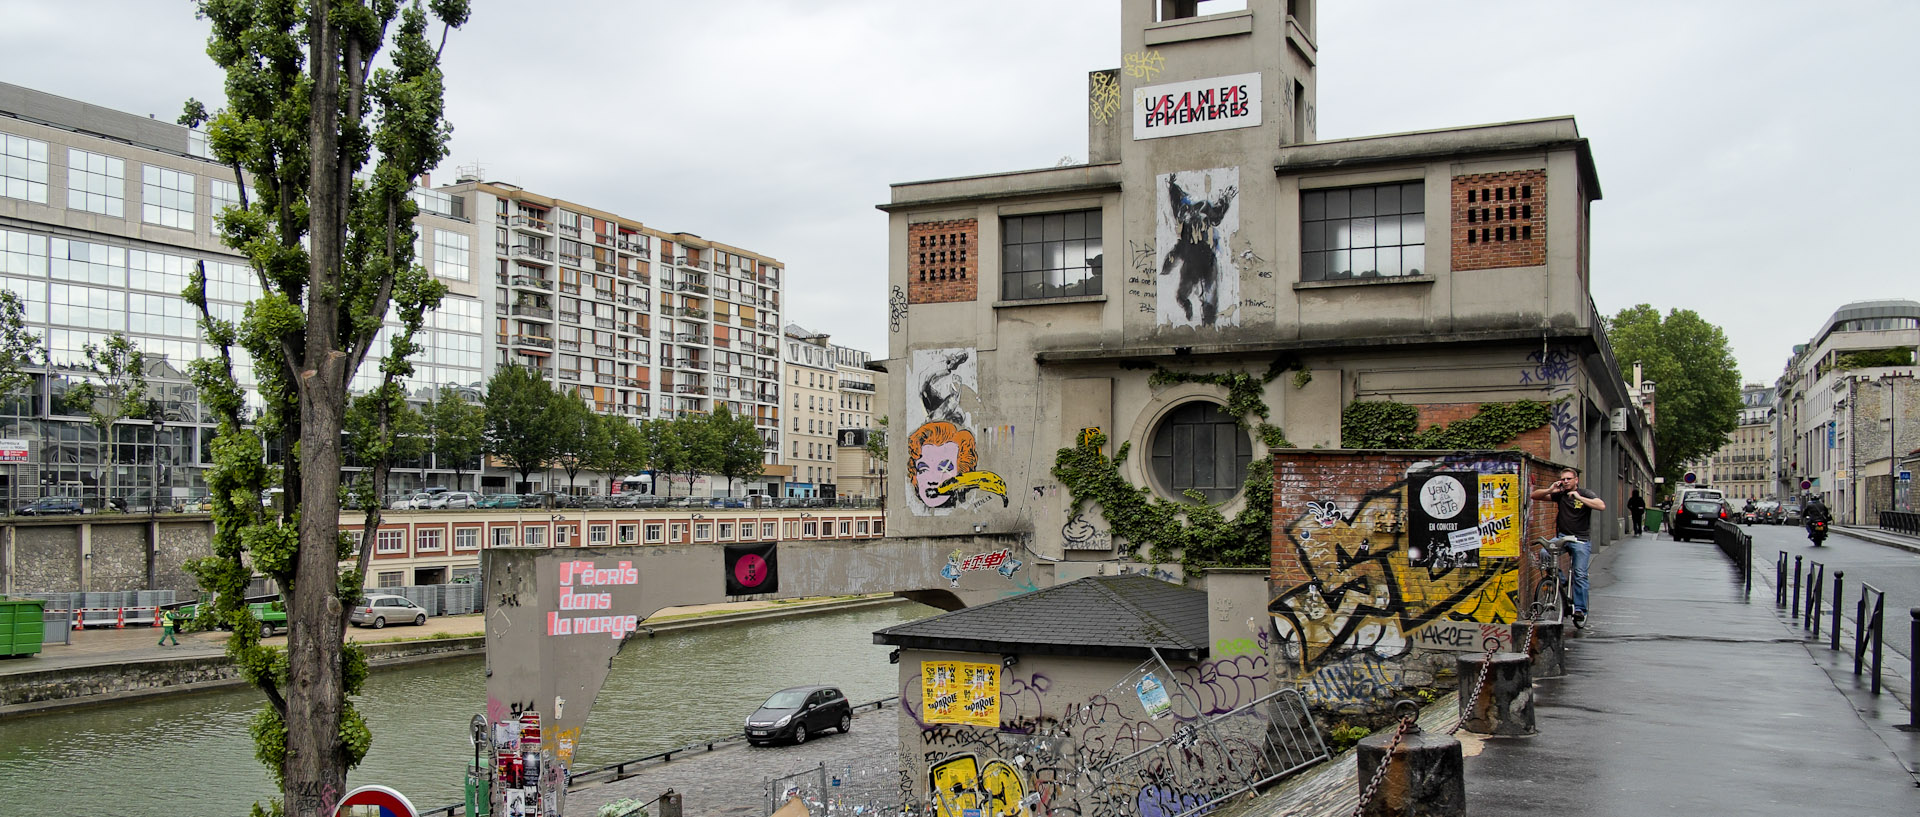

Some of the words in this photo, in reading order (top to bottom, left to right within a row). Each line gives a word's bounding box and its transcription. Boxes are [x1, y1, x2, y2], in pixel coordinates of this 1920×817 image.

[1145, 84, 1248, 111] USINES
[1145, 101, 1249, 128] EPHEMERES
[1428, 523, 1436, 532] EN
[1437, 522, 1459, 531] CONCERT
[560, 586, 612, 611] dans
